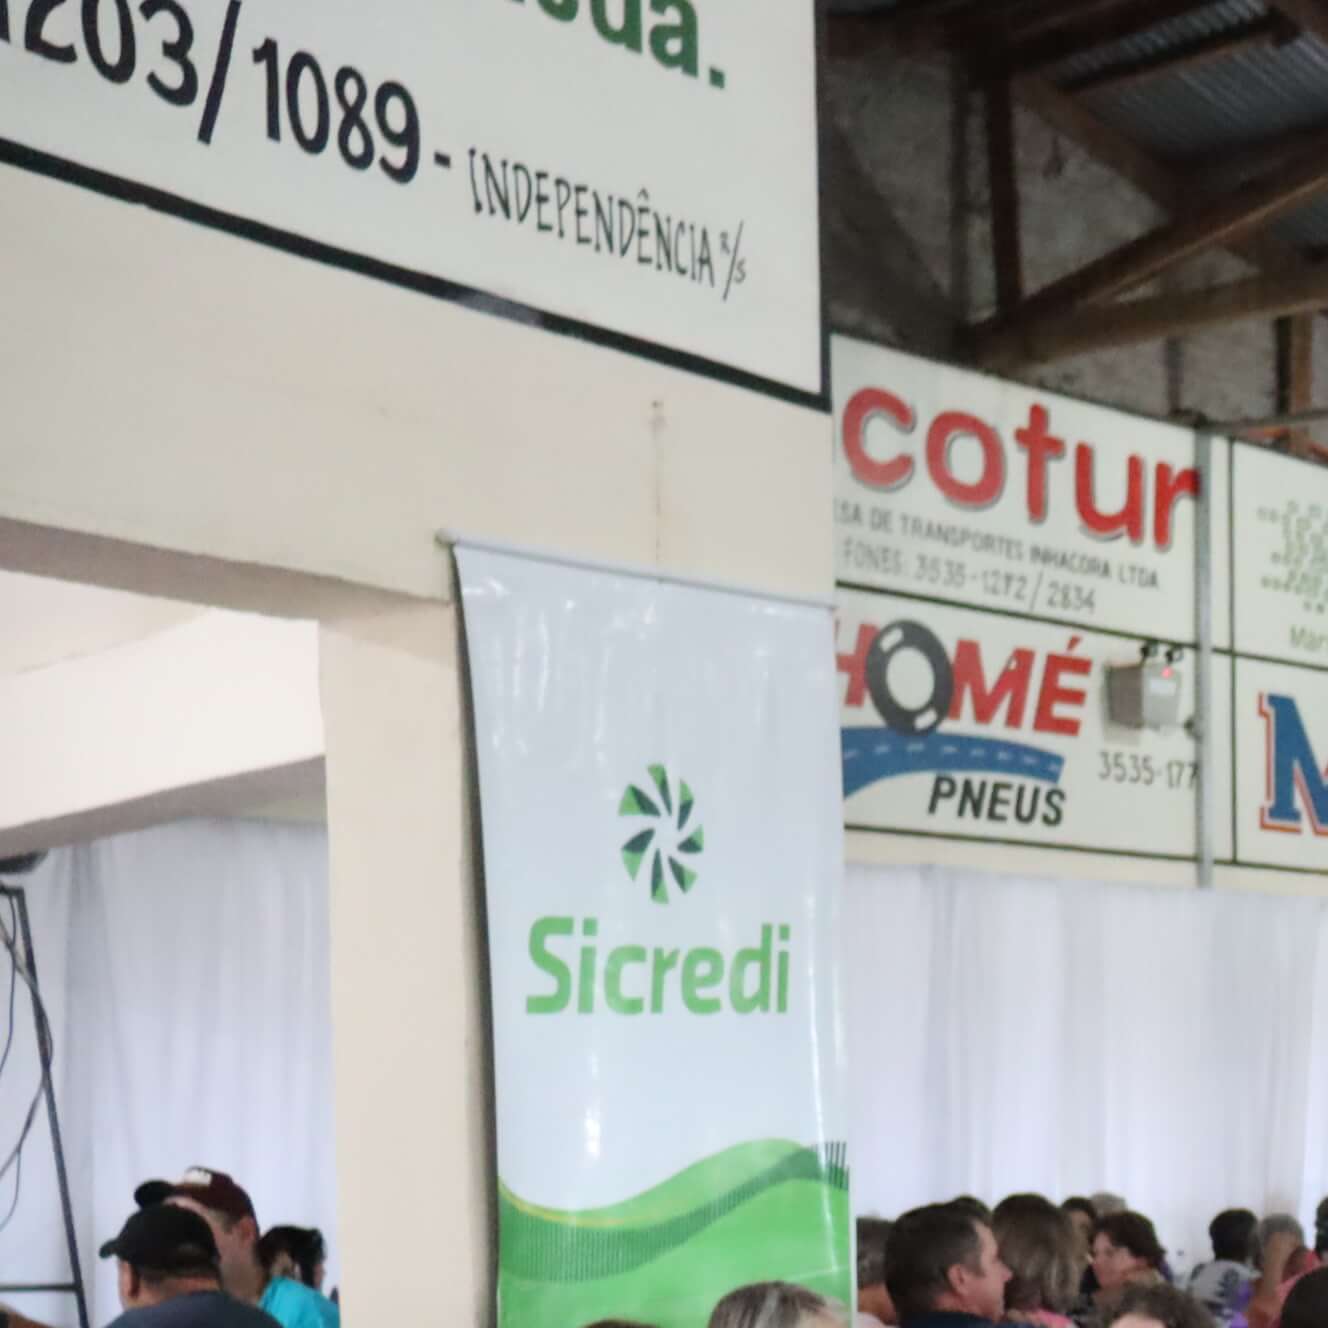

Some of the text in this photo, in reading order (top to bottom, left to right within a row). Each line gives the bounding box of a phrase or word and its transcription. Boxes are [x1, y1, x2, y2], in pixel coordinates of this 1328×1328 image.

[466, 147, 716, 290] INDEPENDÊNCIA
[841, 385, 1201, 554] cotur
[869, 505, 894, 534] DE
[900, 513, 1025, 563] TRANSPORTES
[1118, 561, 1161, 591] LTDA
[927, 773, 1068, 828] PNEUS
[525, 915, 793, 1017] Sicredi
